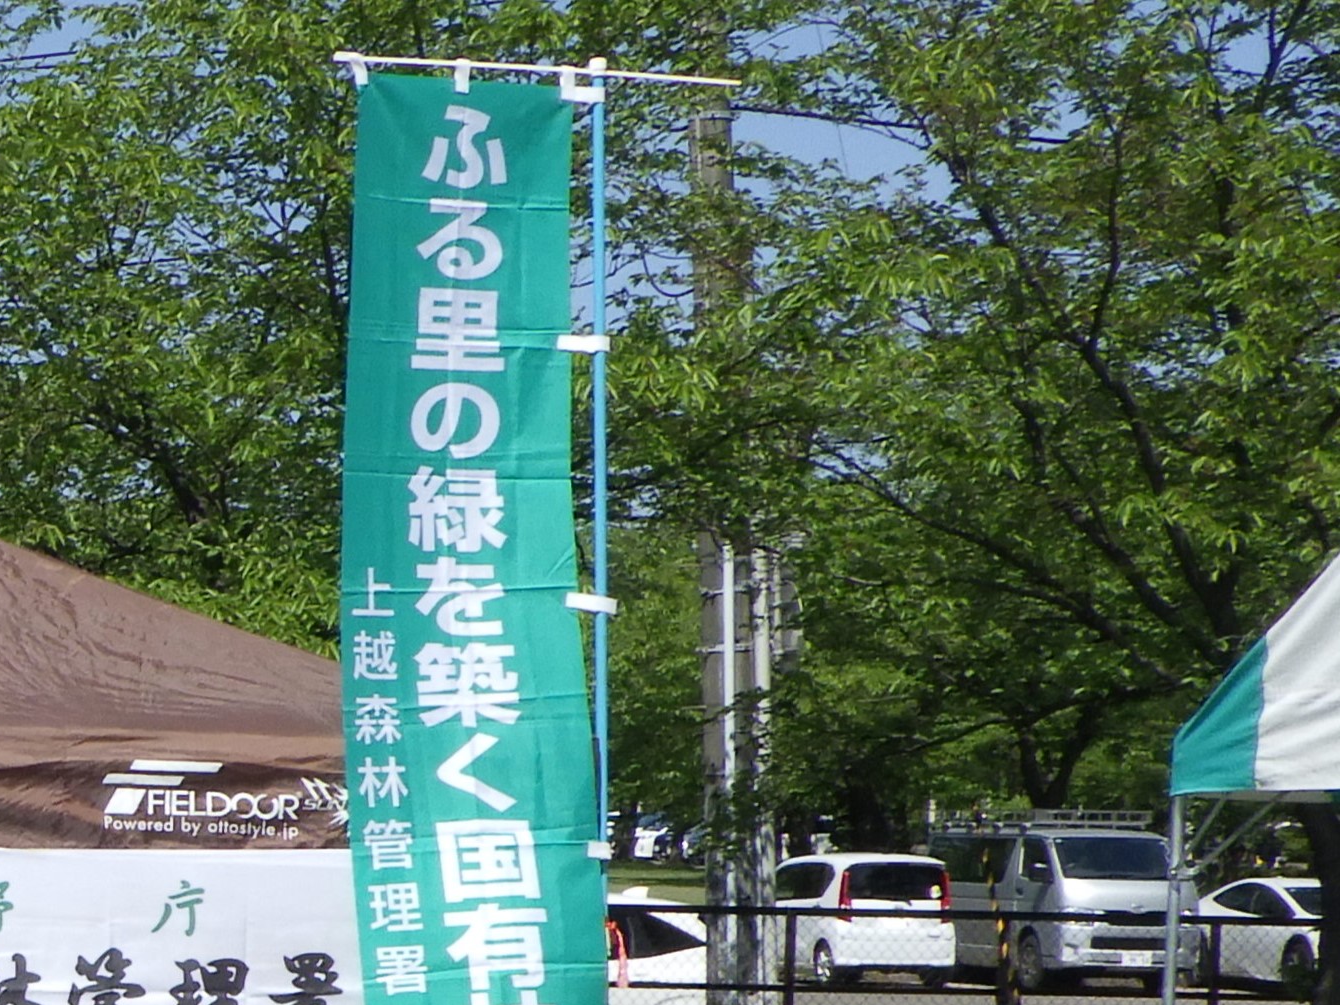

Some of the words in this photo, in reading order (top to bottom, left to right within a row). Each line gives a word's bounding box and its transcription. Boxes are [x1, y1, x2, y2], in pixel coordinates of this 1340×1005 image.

[351, 566, 429, 996] 上越森林管理署
[146, 788, 299, 821] FIELDOOR
[103, 816, 174, 833] Powered
[181, 818, 201, 837] by
[207, 820, 300, 840] ottostyle.jp
